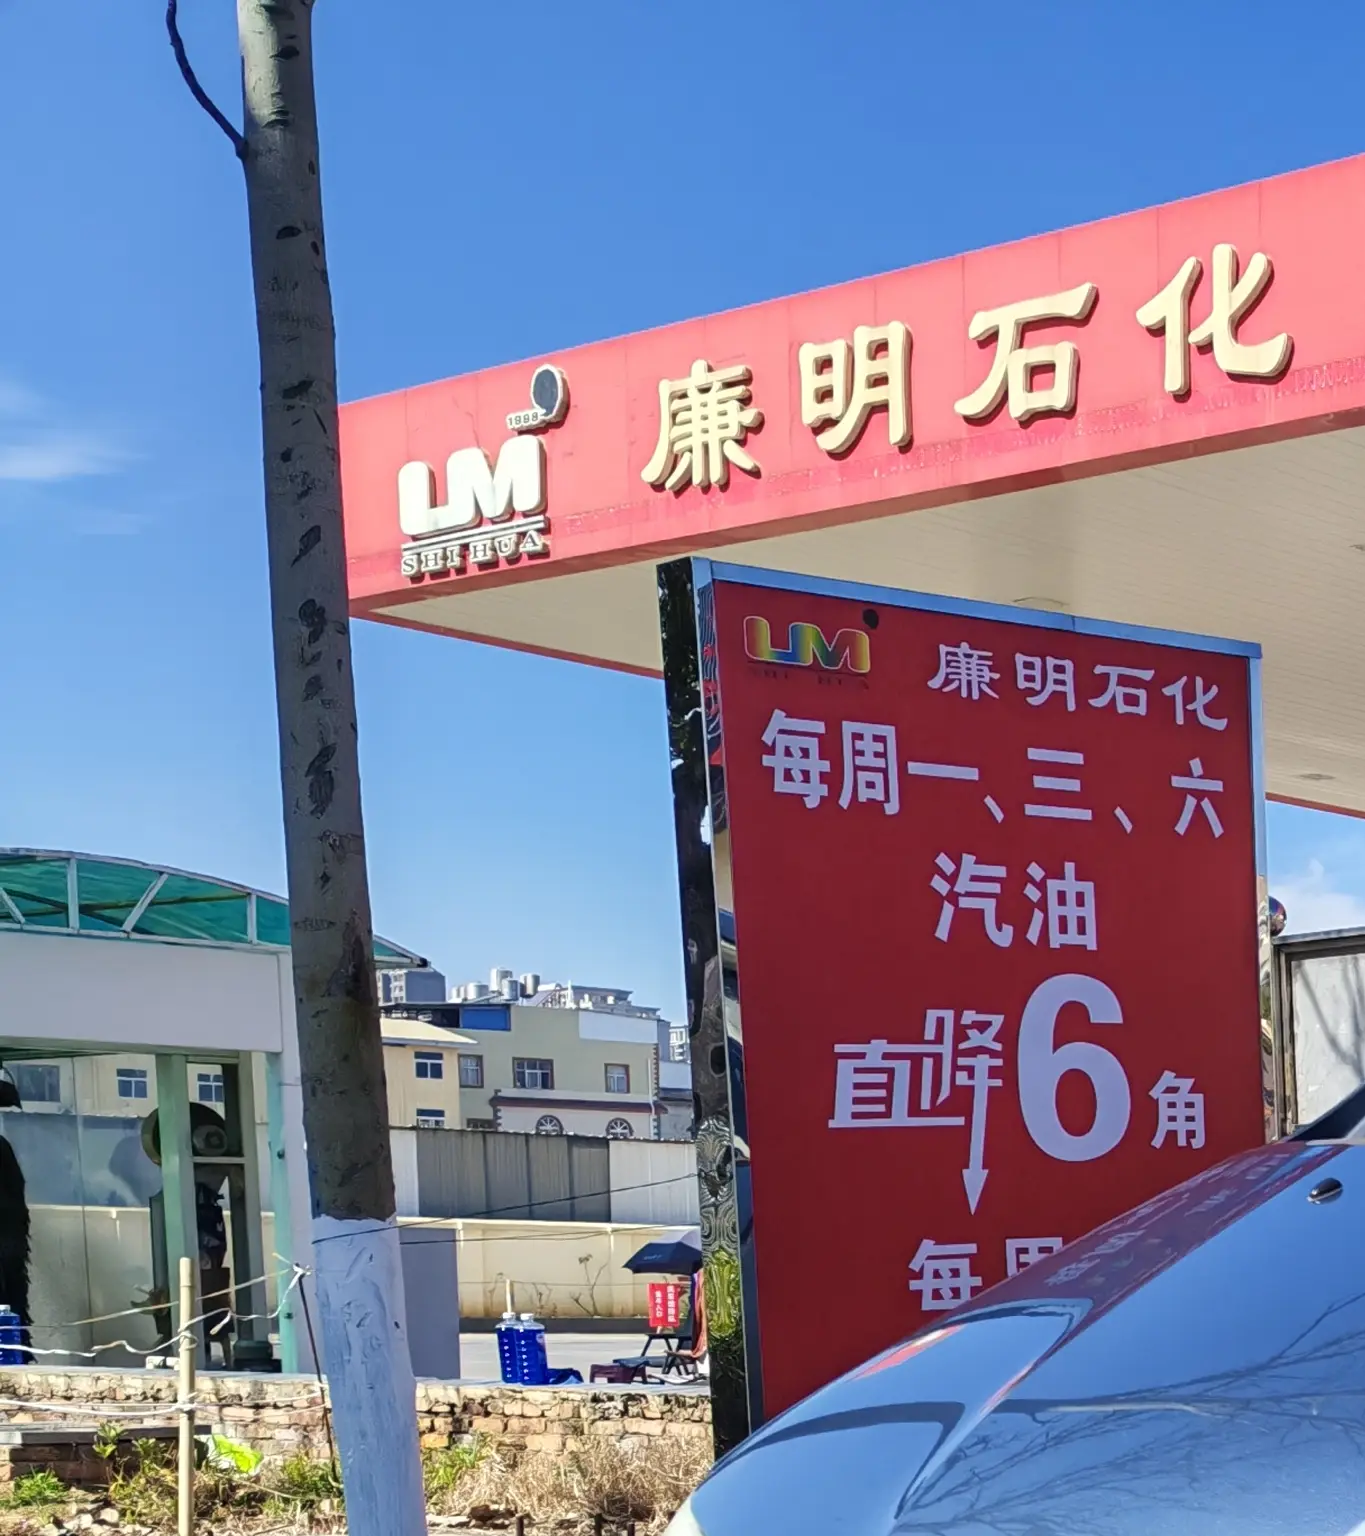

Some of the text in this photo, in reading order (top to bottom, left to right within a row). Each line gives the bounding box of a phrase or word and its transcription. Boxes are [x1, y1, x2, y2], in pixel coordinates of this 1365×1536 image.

[641, 243, 1294, 493] 廉明石化
[398, 434, 546, 537] LM
[743, 615, 871, 673] LM
[926, 641, 1229, 732] 廉明石化
[761, 708, 1226, 838] 每周一、三、六
[930, 852, 1099, 951] 汽油
